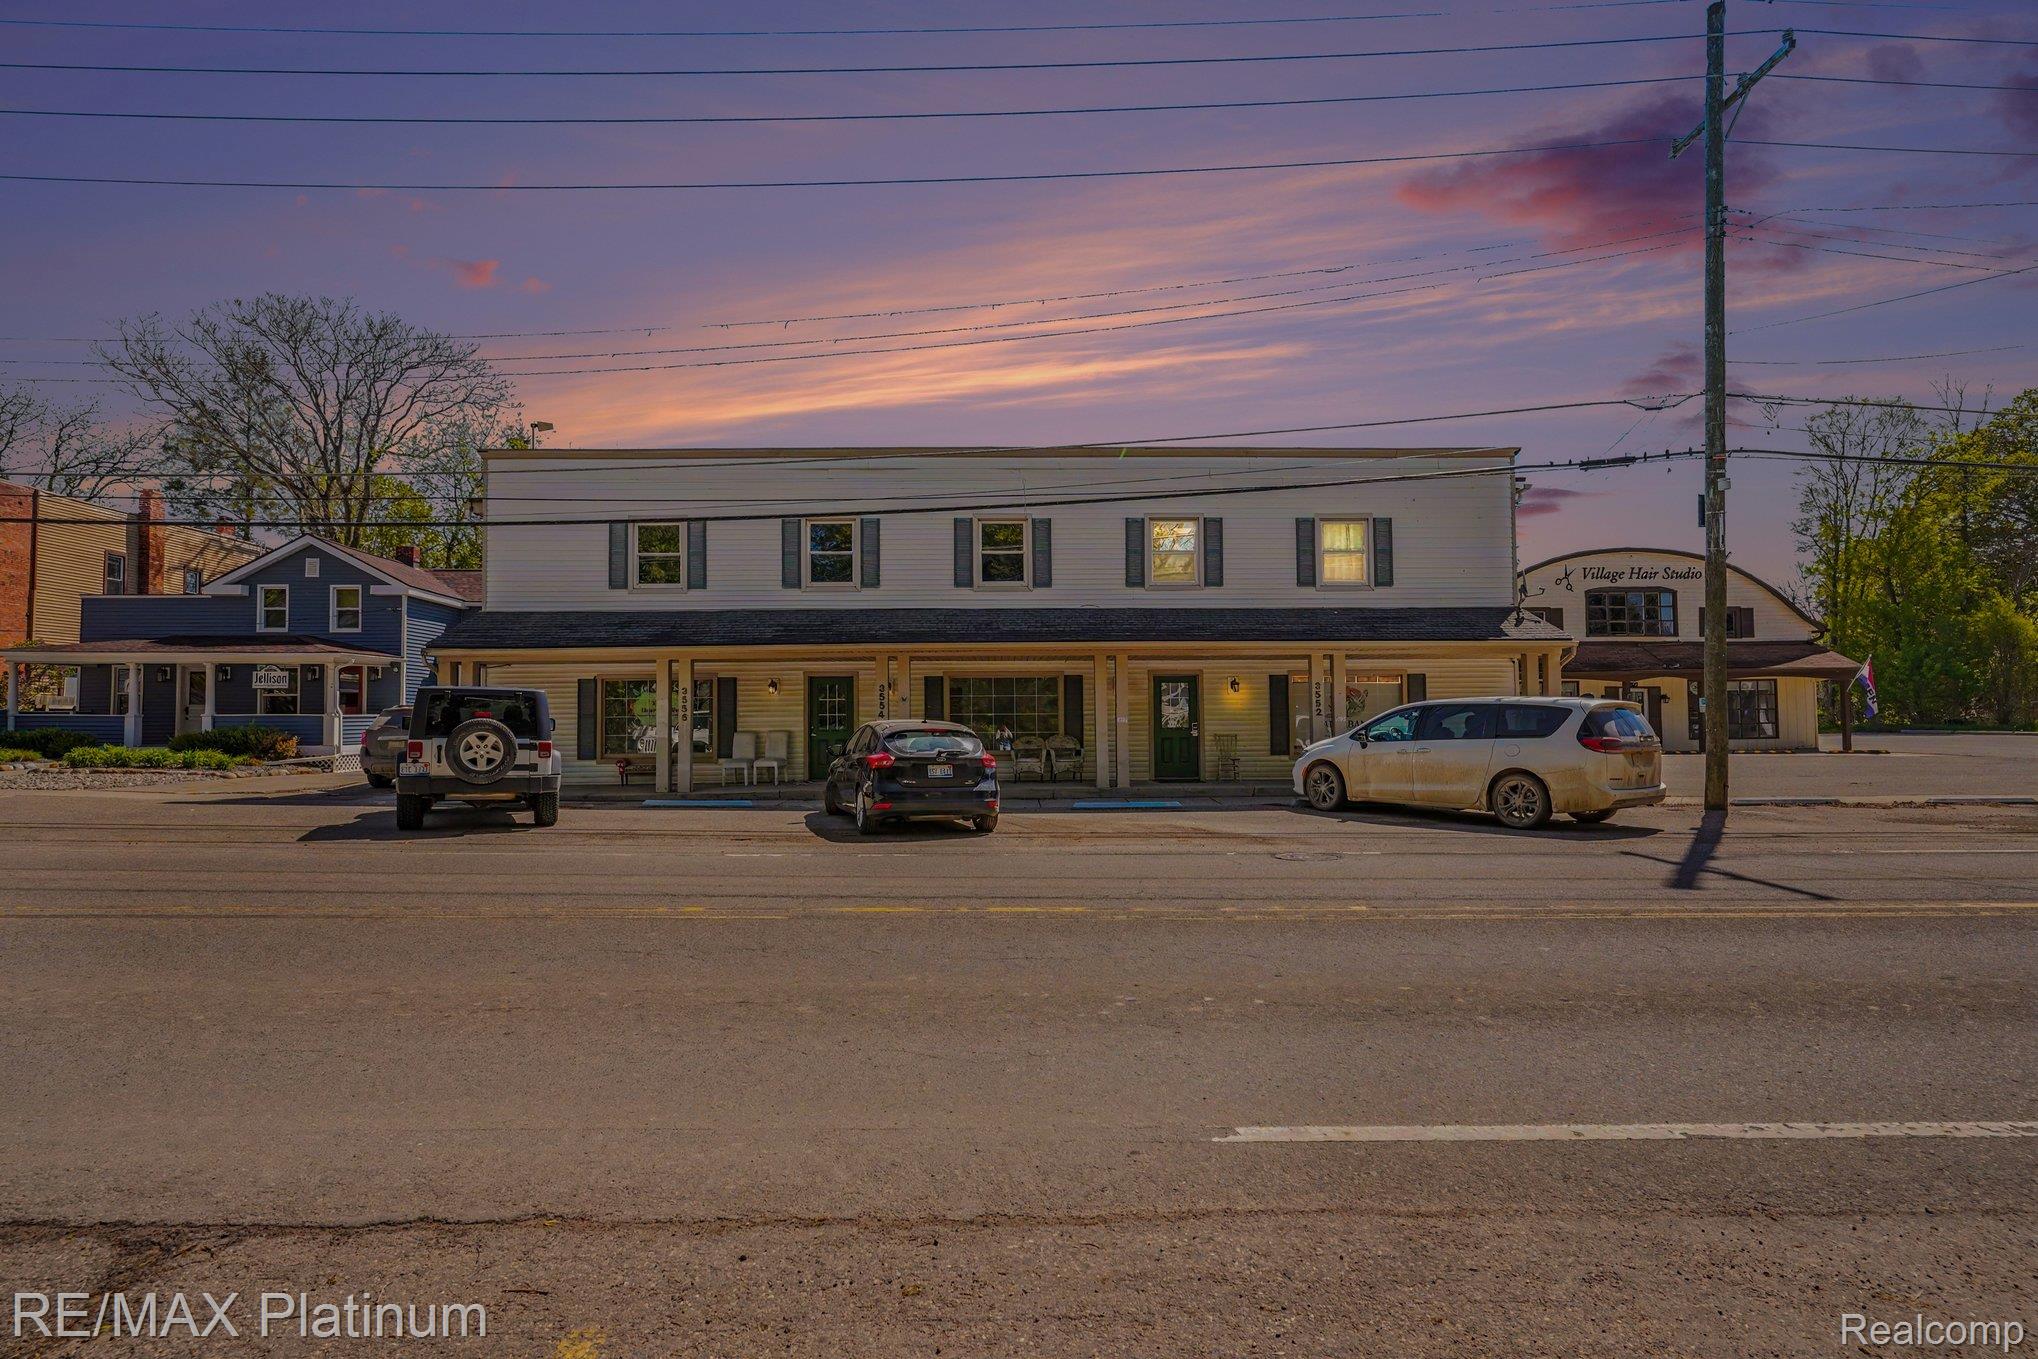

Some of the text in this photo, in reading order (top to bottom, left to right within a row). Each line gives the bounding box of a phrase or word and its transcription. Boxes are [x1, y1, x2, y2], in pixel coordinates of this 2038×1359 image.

[1582, 567, 1703, 583] Village Hair Studio
[254, 672, 287, 684] Jellison
[1314, 681, 1322, 717] 3552
